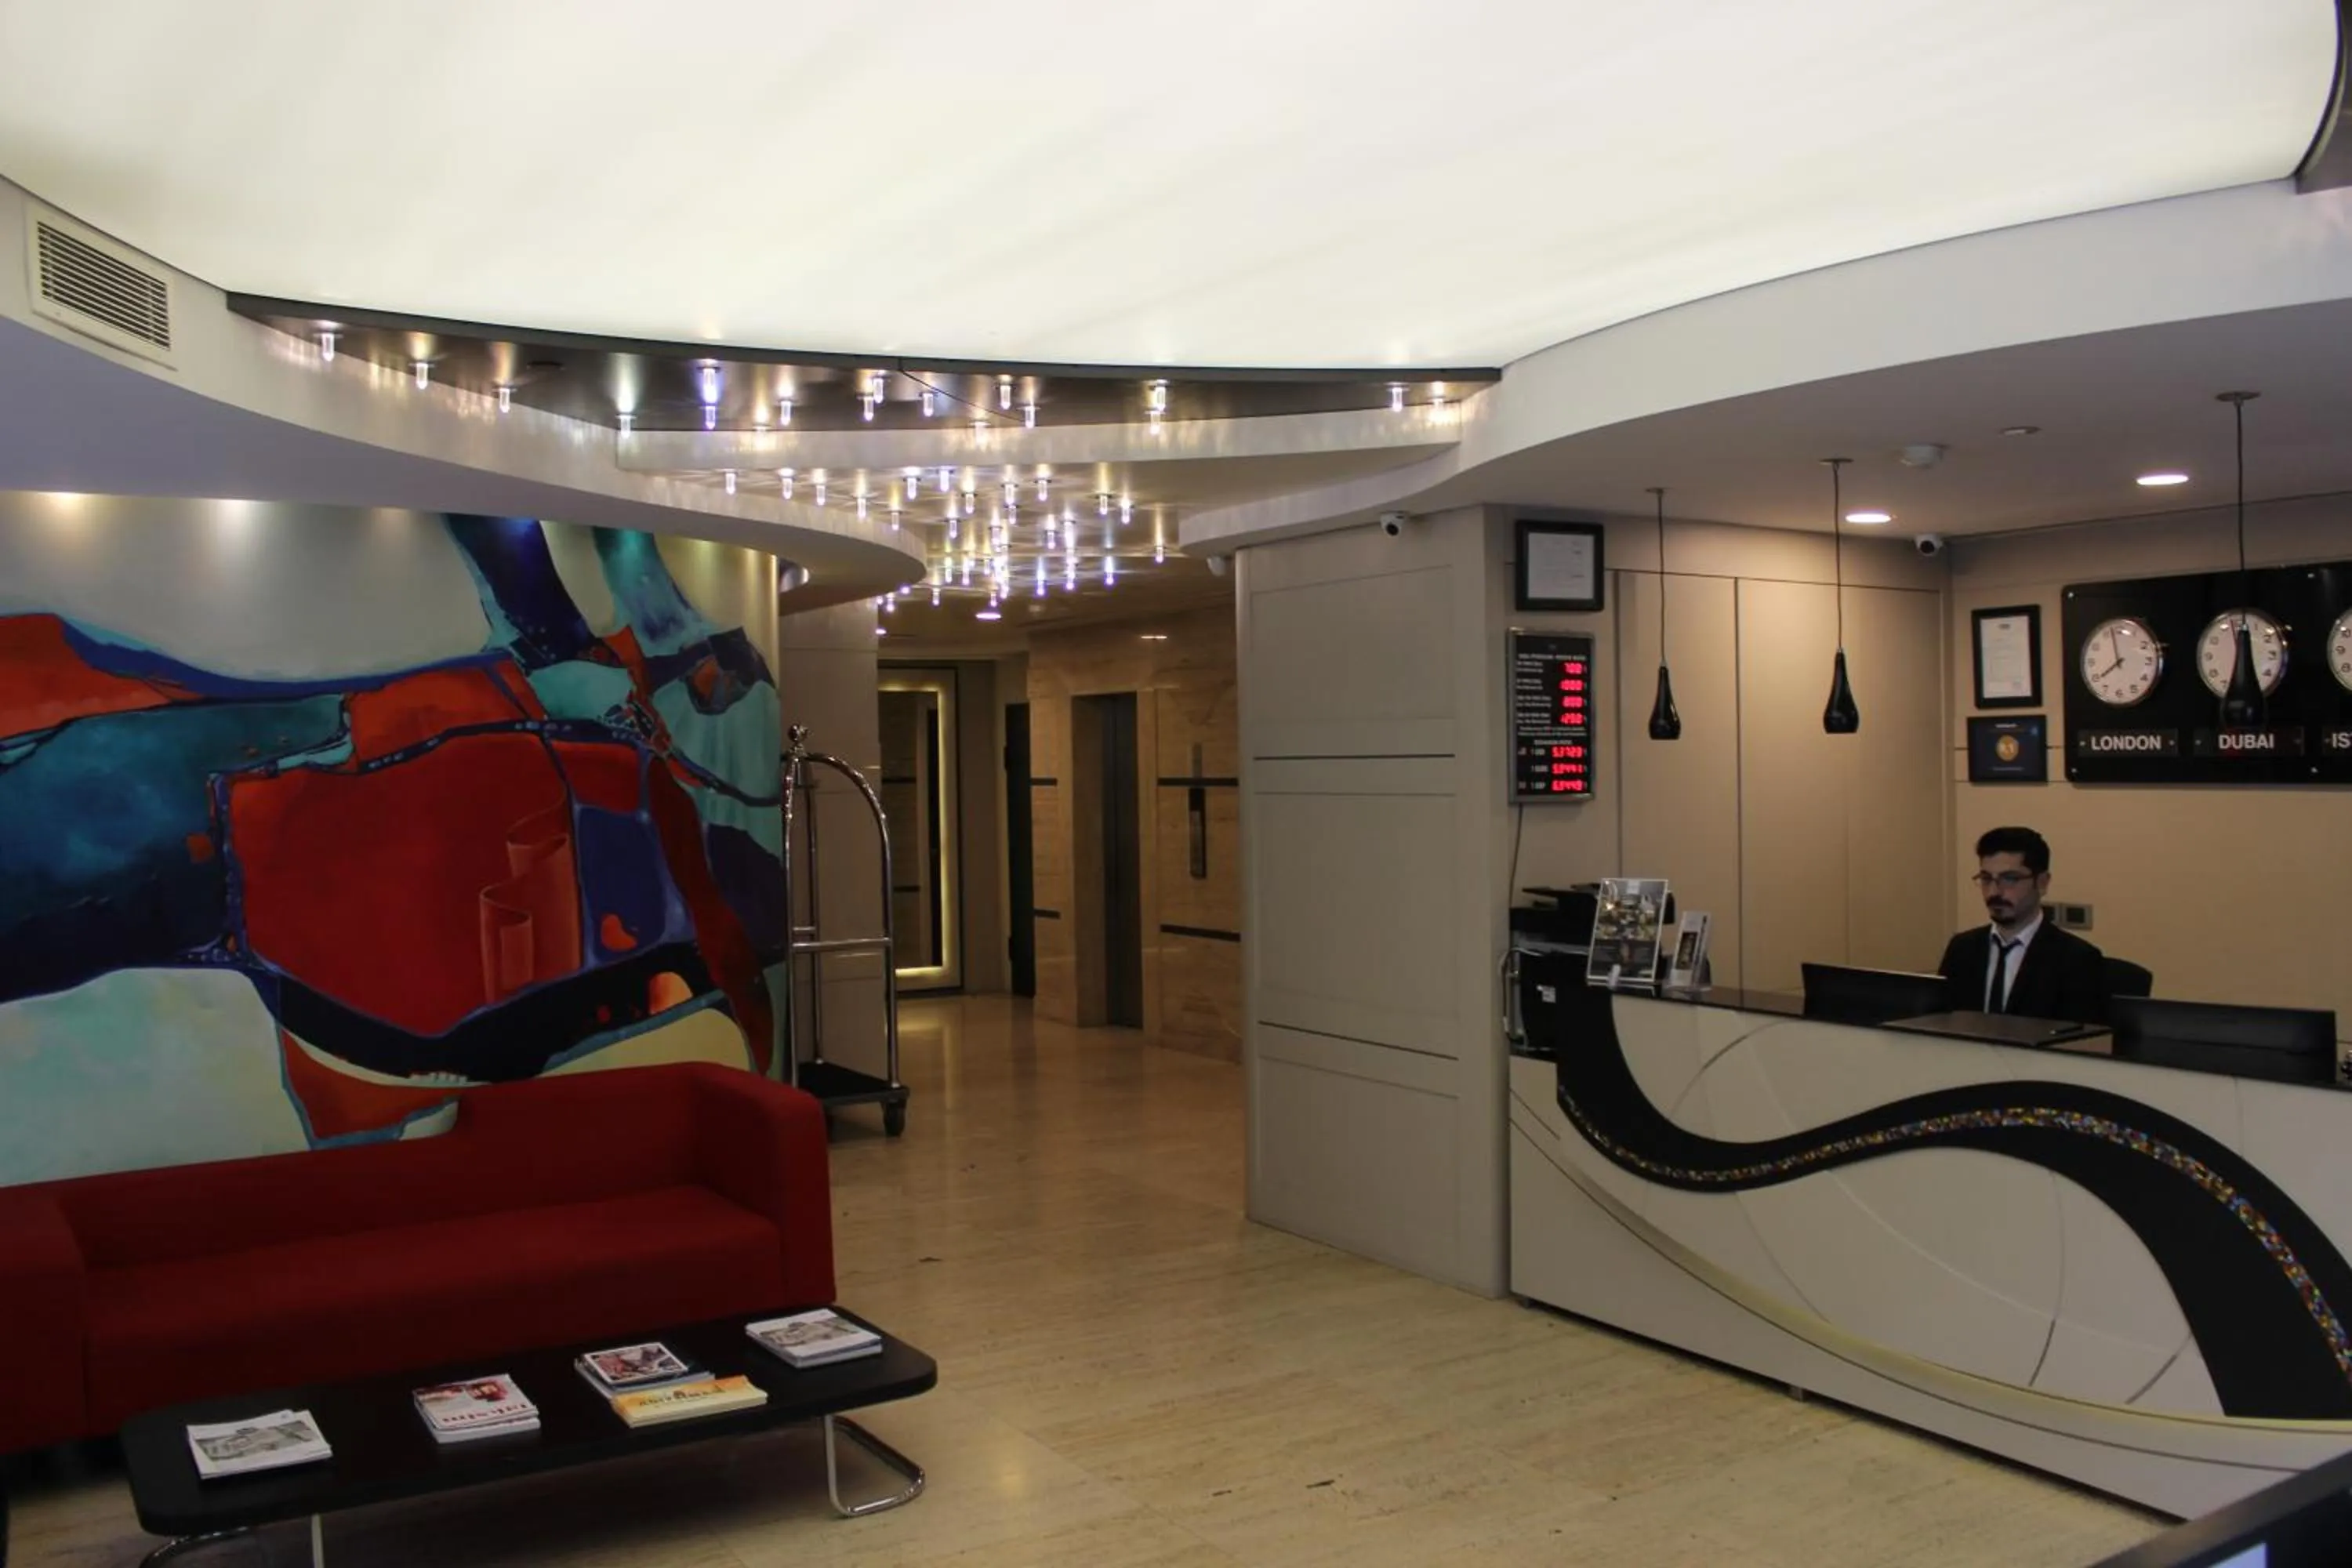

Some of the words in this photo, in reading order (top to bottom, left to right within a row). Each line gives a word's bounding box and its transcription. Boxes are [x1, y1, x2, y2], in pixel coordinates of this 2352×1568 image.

[2140, 641, 2148, 650] 2
[2336, 645, 2345, 655] 9
[2341, 662, 2350, 673] 8
[2139, 673, 2149, 682] 4
[2102, 684, 2109, 694] 7
[2114, 688, 2124, 699] 6
[2129, 684, 2139, 694] 5
[2091, 735, 2162, 750] LONDON
[2219, 734, 2274, 749] DUBAI
